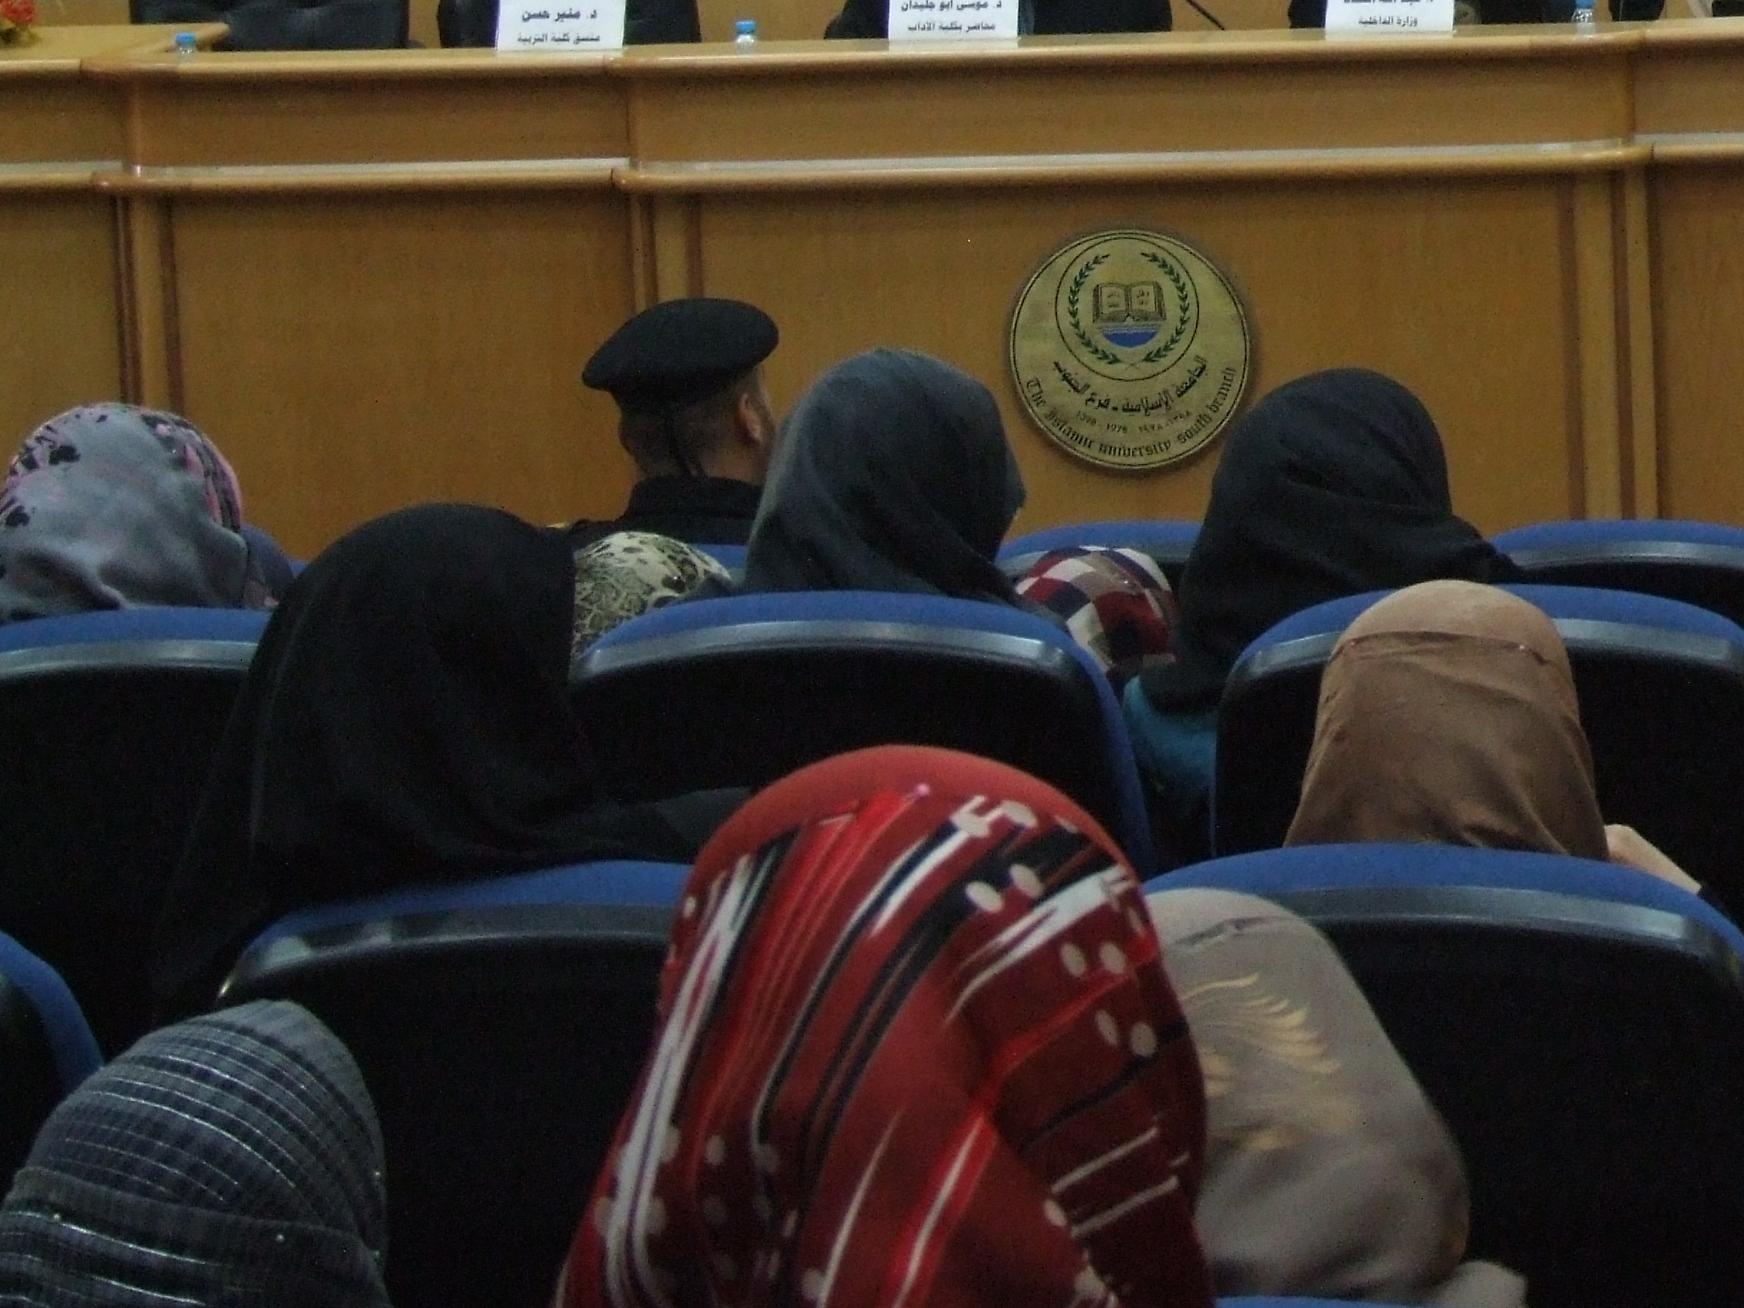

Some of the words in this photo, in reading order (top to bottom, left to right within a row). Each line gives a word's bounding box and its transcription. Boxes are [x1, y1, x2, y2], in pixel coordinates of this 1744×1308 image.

[956, 1, 989, 11] موسى
[554, 7, 581, 22] منير
[1175, 354, 1208, 398] الجامعة
